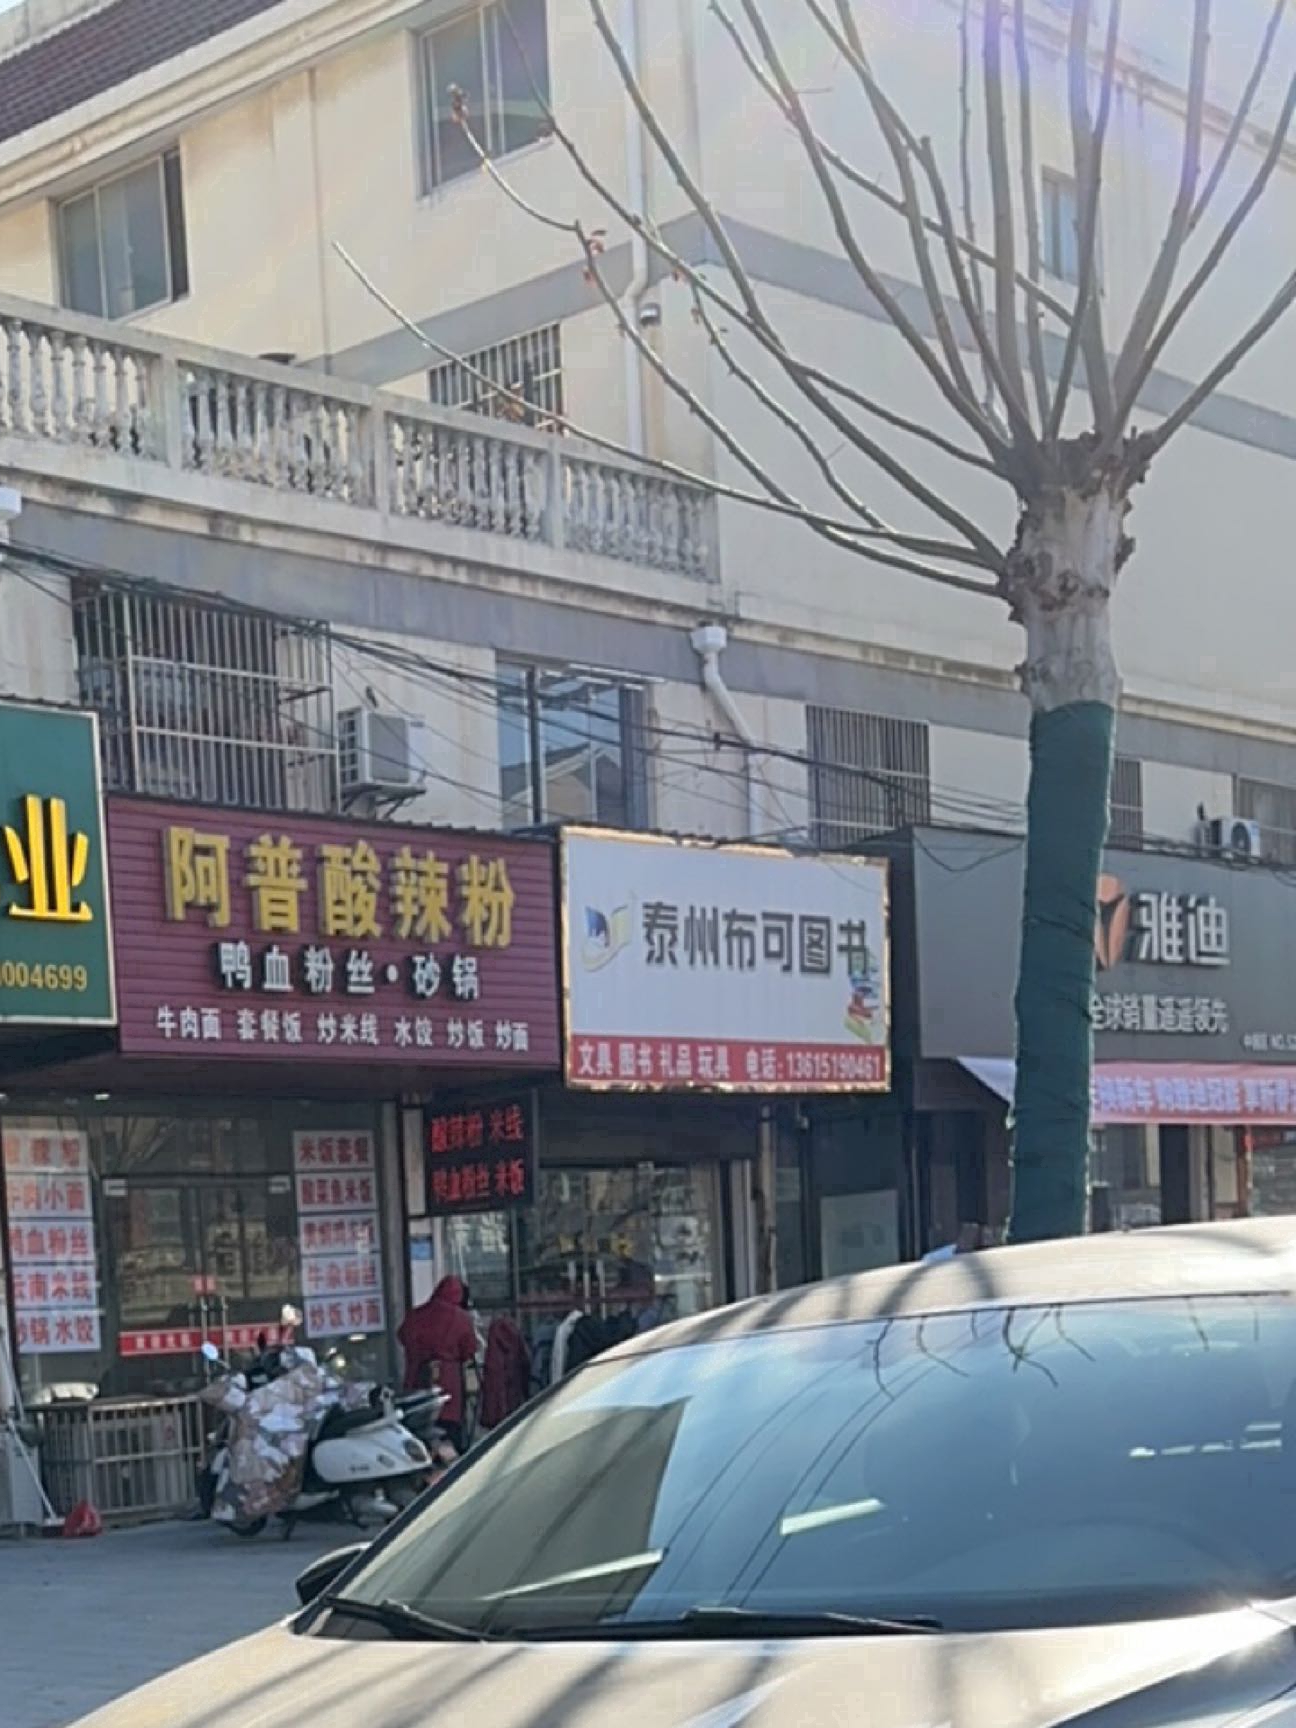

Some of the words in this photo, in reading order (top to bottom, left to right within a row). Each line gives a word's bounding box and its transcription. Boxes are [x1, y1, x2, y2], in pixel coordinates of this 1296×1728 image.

[162, 825, 516, 948] 阿普酸辣粉
[641, 899, 874, 978] 泰州布可图书
[1138, 892, 1231, 966] 雅迪
[157, 1005, 222, 1040] 牛肉面
[236, 1008, 302, 1043] 套餐饭
[316, 1010, 380, 1046] 炒米线
[393, 1015, 434, 1048] 水饺
[446, 1016, 484, 1049] 炒饭
[495, 1018, 530, 1052] 炒面
[577, 1040, 614, 1076] 文具
[617, 1042, 653, 1077] 图书
[659, 1043, 693, 1078] 礼品
[697, 1045, 730, 1079] 玩具
